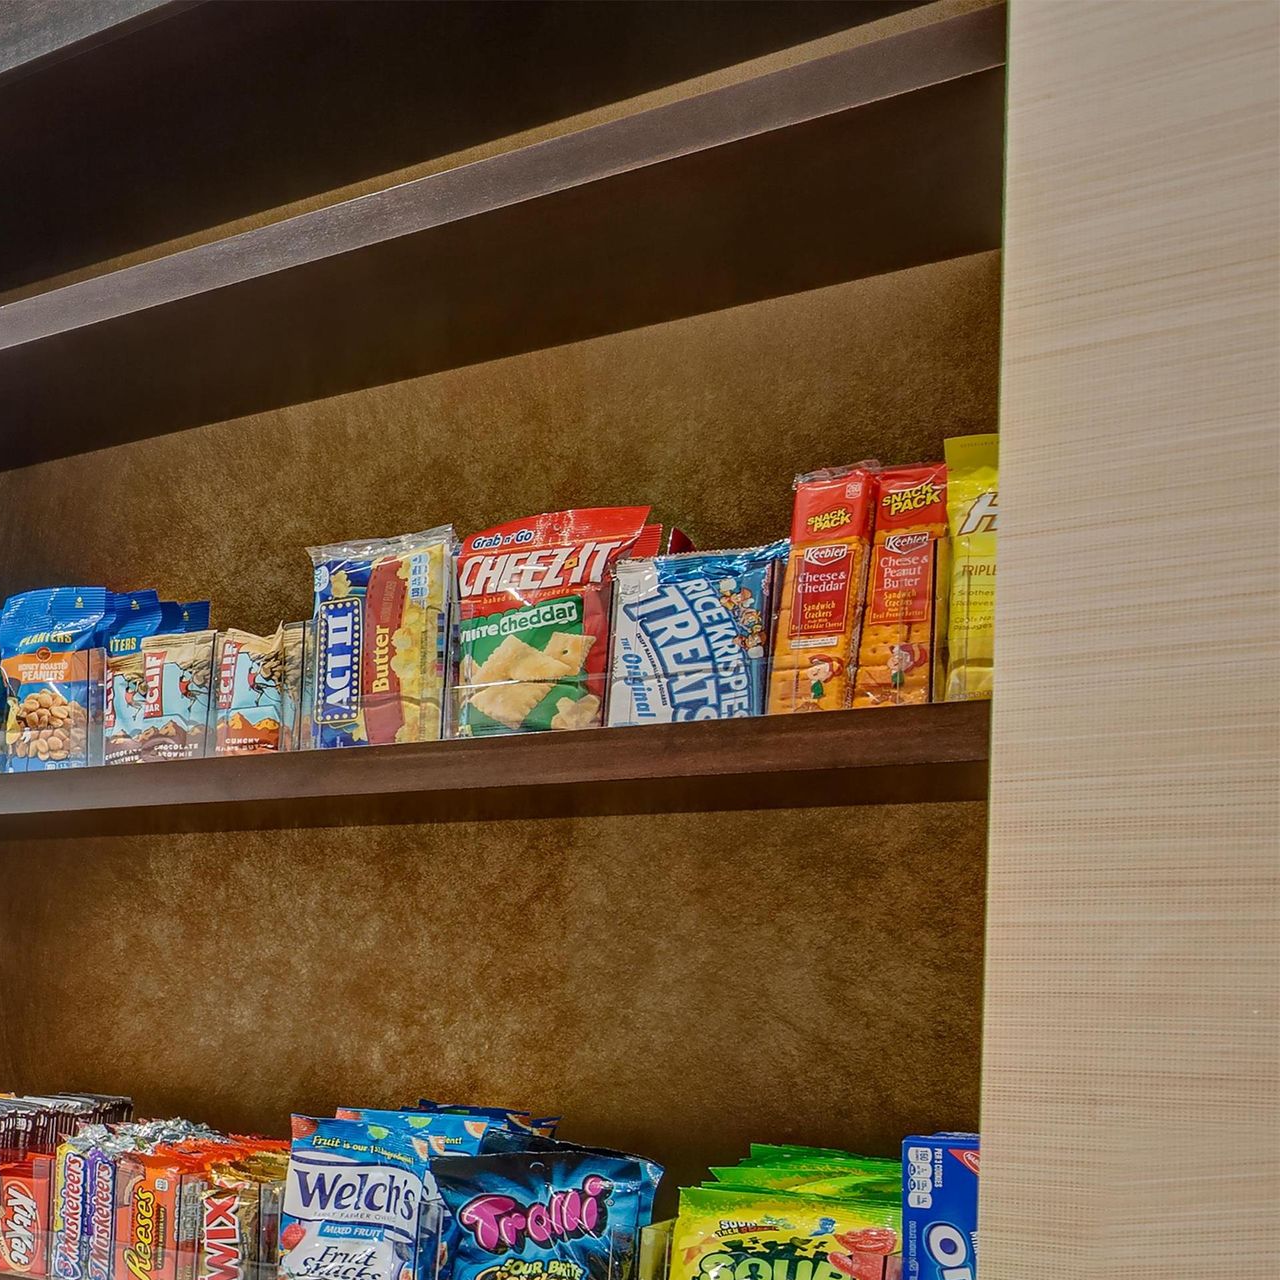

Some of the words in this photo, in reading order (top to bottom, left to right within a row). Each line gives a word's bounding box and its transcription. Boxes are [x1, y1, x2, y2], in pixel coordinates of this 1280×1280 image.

[882, 483, 934, 506] SNACK
[890, 491, 942, 516] PACK
[807, 508, 847, 526] SNACK
[813, 513, 852, 532] PACK
[473, 535, 500, 549] Grab
[515, 530, 532, 542] Go
[806, 546, 847, 560] Keebler
[880, 556, 919, 567] Cheese
[798, 571, 838, 583] Cheese
[884, 566, 921, 577] Peanut
[797, 581, 845, 593] Cheddar
[680, 578, 730, 624] RICE
[803, 601, 836, 612] Sandwich
[502, 605, 575, 633] cheddar
[805, 610, 833, 620] Crackers
[328, 612, 352, 648] II
[16, 632, 72, 652] PLANTERS
[620, 637, 632, 652] THE
[18, 663, 40, 671] HONEY
[220, 641, 237, 693] CLIF
[372, 625, 390, 693] Butter
[21, 670, 65, 681] PEANUTS
[147, 656, 161, 703] CLIF
[326, 653, 351, 710] ACT
[621, 653, 656, 717] Original
[312, 1136, 340, 1148] Fruit
[343, 1141, 352, 1149] is
[294, 1169, 415, 1221] Welch's
[60, 1154, 84, 1262] Musketeers
[92, 1163, 112, 1268] Musketeers
[462, 1176, 605, 1250] Trolli
[324, 1225, 351, 1235] MIXED
[354, 1227, 382, 1237] FRUIT
[318, 1246, 378, 1266] Fruit
[501, 1259, 543, 1275] SOUR
